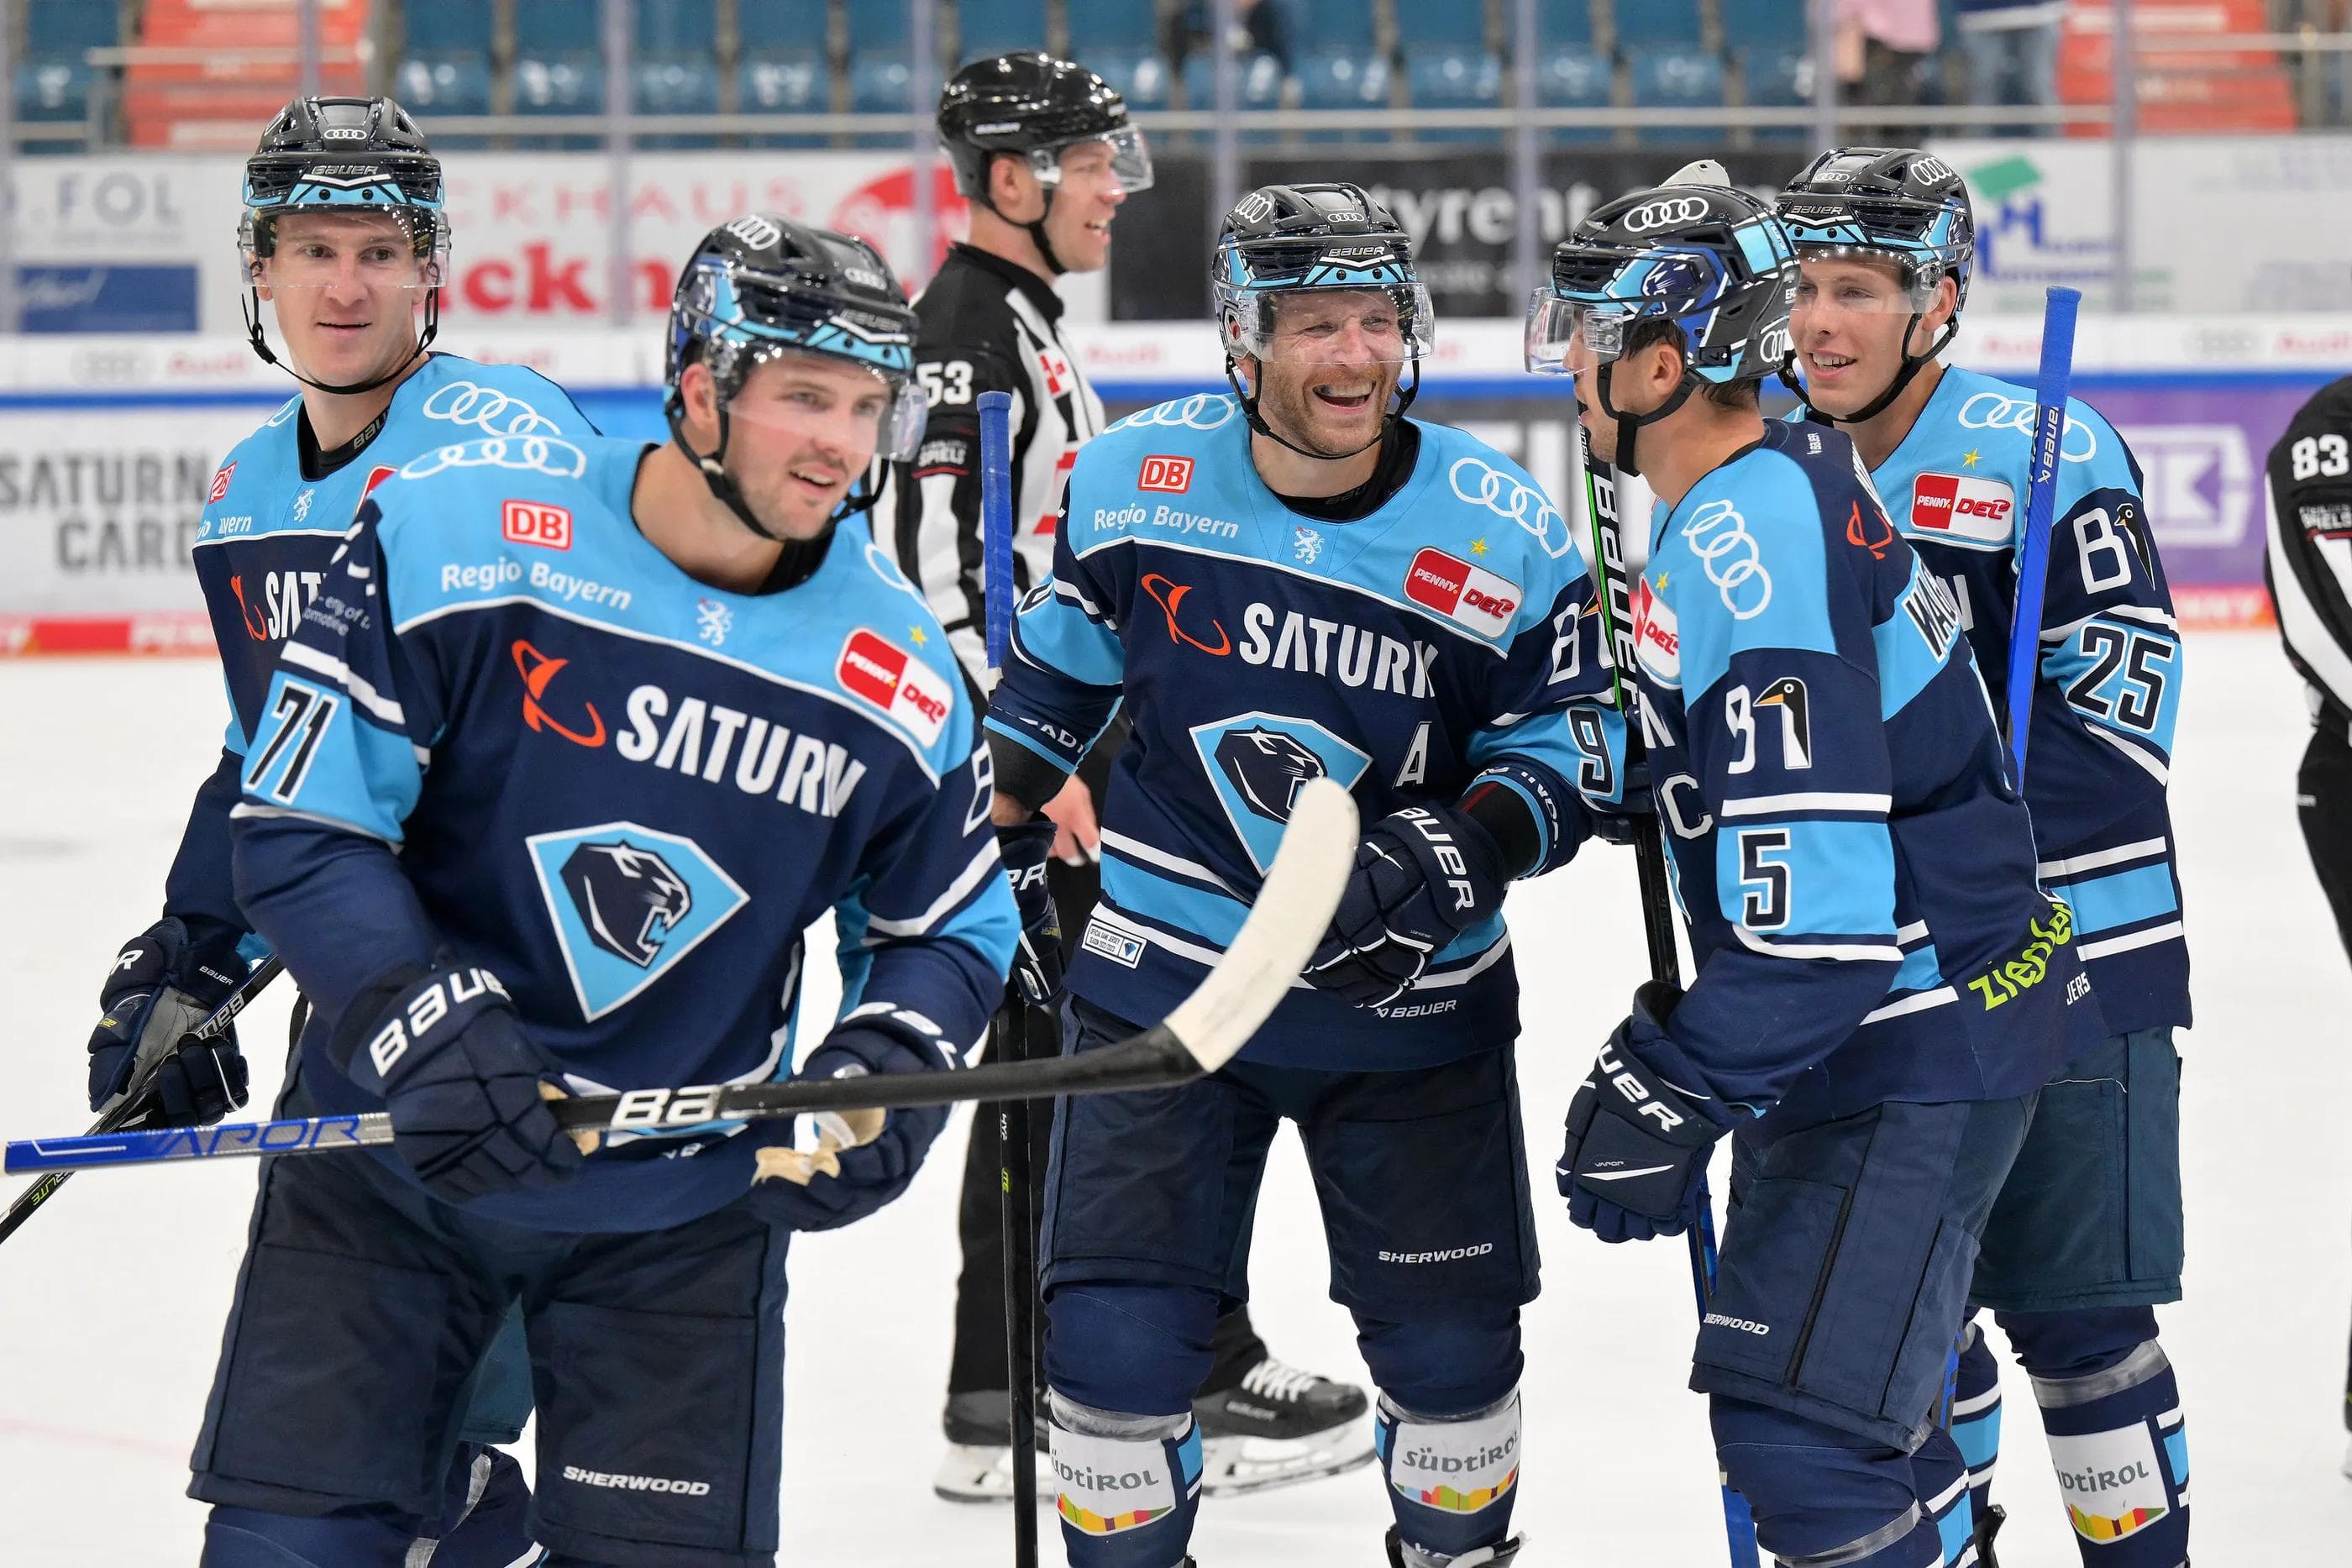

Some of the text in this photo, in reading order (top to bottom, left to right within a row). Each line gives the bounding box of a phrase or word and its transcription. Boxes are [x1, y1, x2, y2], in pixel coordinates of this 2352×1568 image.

[1790, 205, 1844, 216] BAUER
[1328, 247, 1385, 257] BAUER
[915, 359, 974, 409] 53
[1144, 460, 1185, 486] DB
[2292, 433, 2350, 481] 83
[510, 507, 564, 543] DB
[1094, 503, 1239, 539] Regio Bayern
[440, 557, 633, 611] Regio Bayern
[2065, 622, 2175, 733] 25
[242, 679, 340, 805] 71
[1395, 721, 1432, 788] A
[1657, 773, 1714, 841] C
[1737, 827, 1792, 931] 5
[198, 966, 234, 986] BAUER
[1389, 999, 1457, 1019] BAUER
[1378, 1242, 1494, 1265] SHERWOOD
[564, 1466, 711, 1497] SHERWOOD
